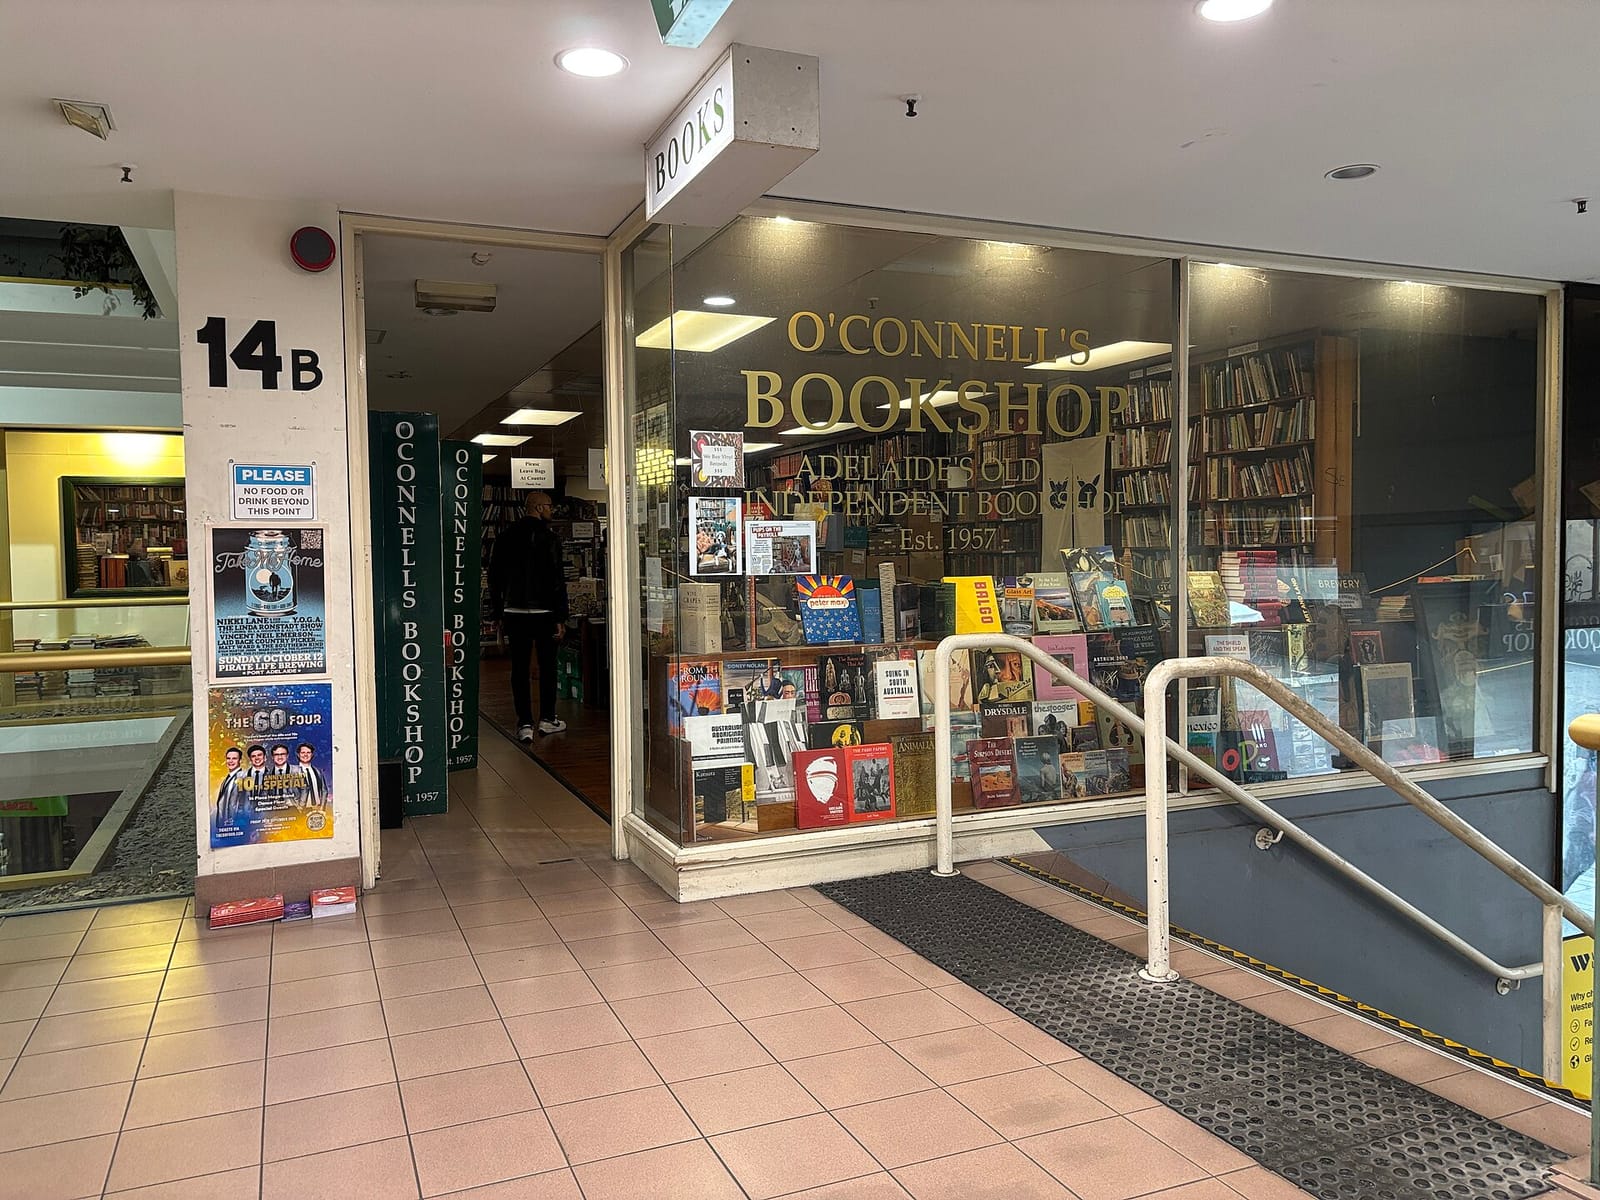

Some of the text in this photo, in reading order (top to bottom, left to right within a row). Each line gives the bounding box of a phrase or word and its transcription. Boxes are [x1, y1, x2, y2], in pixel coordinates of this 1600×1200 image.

[655, 88, 724, 195] BOOKS
[787, 311, 1090, 365] O'CONNELL'S
[740, 369, 1129, 437] BOOKSHOP
[794, 454, 974, 482] ADELAIDE'S
[242, 470, 305, 482] PLEASE
[261, 488, 288, 496] FOOD
[271, 498, 310, 506] BEYOND
[744, 490, 969, 517] INDEPENDENT
[900, 528, 997, 550] Est. 1957
[1318, 579, 1360, 589] BREWERY
[396, 421, 424, 784] OCONNELLS BOOKSHOP
[450, 449, 469, 750] OCONNELLS BOOKSHOP
[810, 599, 828, 608] peter
[974, 581, 994, 624] BALGO
[218, 655, 261, 664] SUNDAY
[264, 654, 312, 663] OCTOBER
[313, 653, 323, 661] 12
[218, 661, 323, 672] PIRATE LIFE BREWING
[889, 678, 906, 686] SOUTH
[883, 687, 914, 696] AUSTRALIA
[984, 706, 1028, 716] DRYSDALE
[225, 708, 322, 732] THE 60 FOUR
[456, 755, 473, 764] 1957
[263, 779, 306, 790] SPECIAL
[416, 792, 439, 802] 1957
[1570, 992, 1585, 1002] Why
